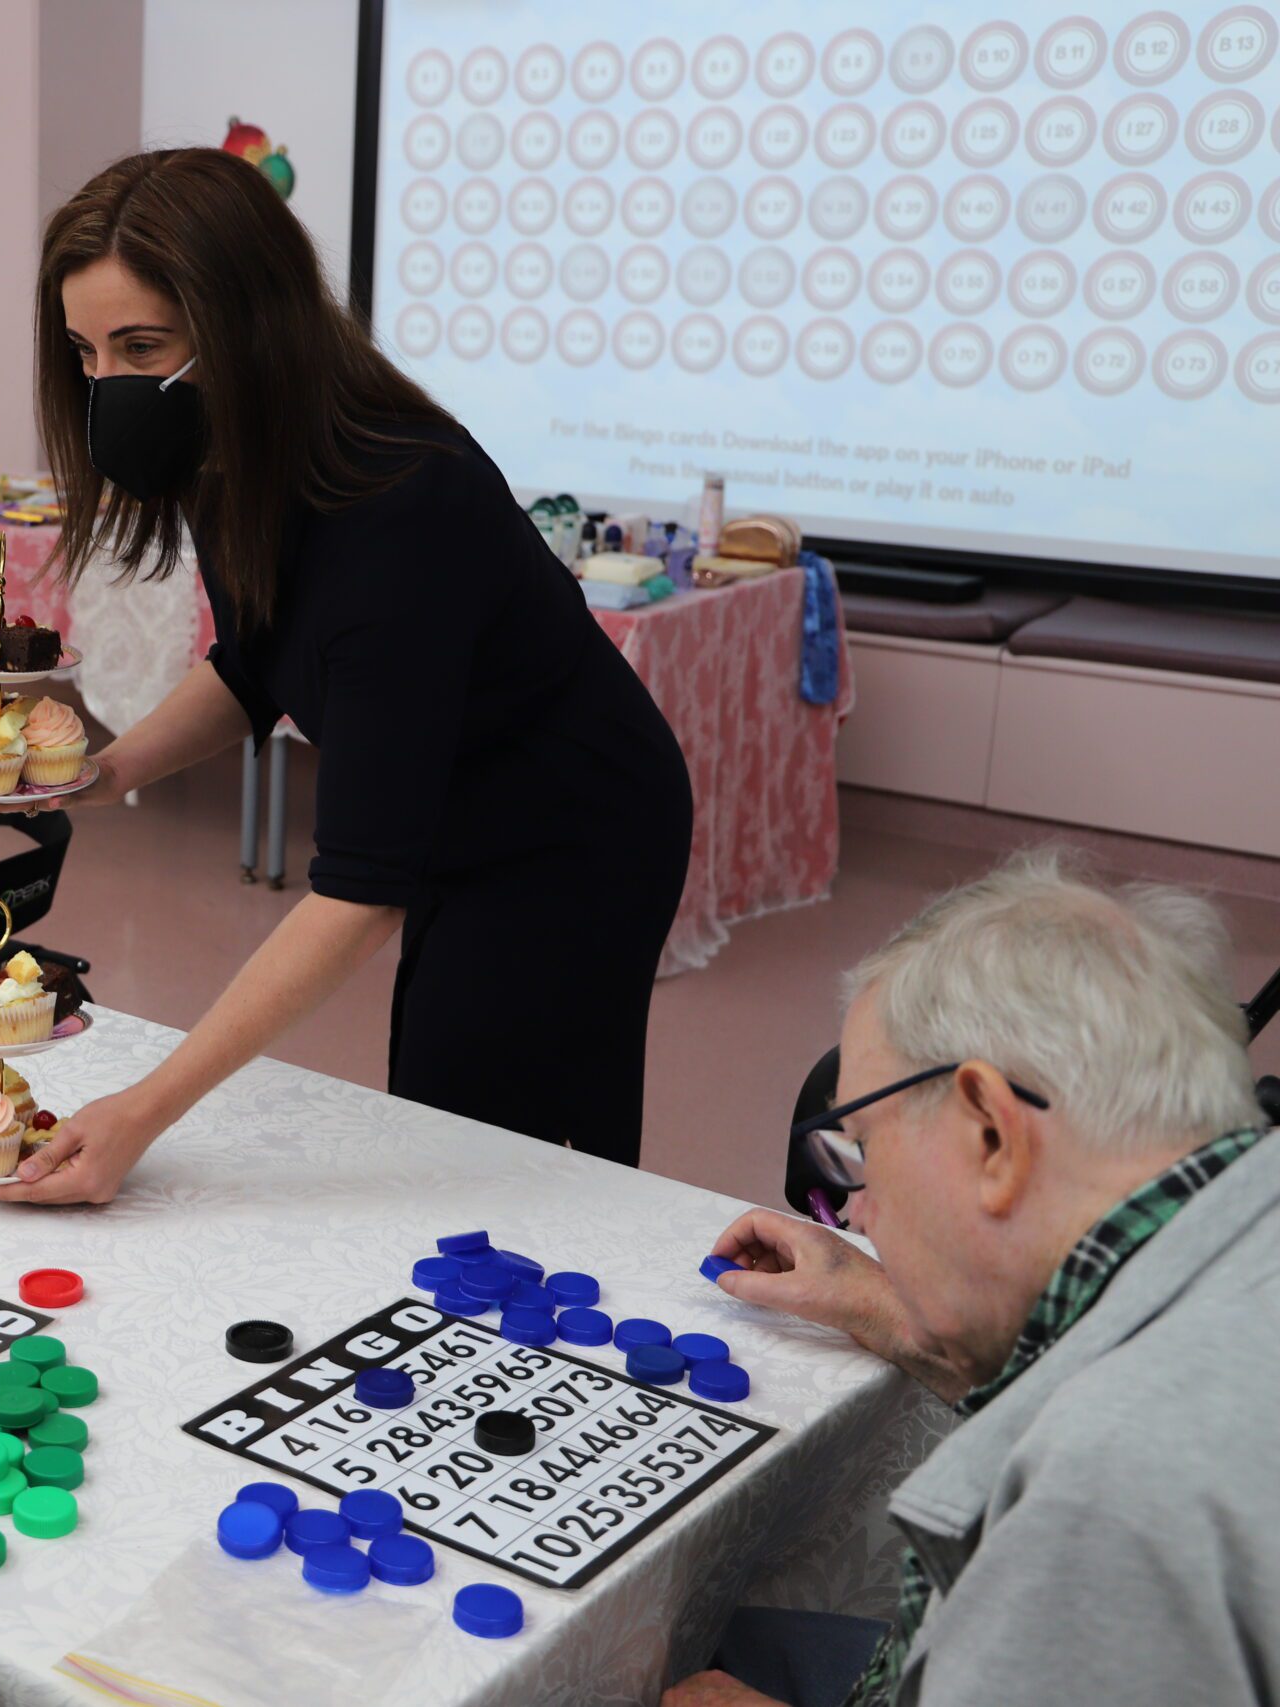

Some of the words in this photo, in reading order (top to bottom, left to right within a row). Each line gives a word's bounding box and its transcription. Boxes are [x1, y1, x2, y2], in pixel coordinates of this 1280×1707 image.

[1151, 40, 1168, 56] 12
[1237, 35, 1255, 51] 13
[992, 48, 1010, 62] 10
[1071, 45, 1085, 59] 11
[1054, 124, 1074, 138] 26
[1135, 121, 1155, 136] 27
[1217, 118, 1240, 134] 28
[1127, 201, 1148, 215] 42
[1210, 200, 1231, 215] 43
[1118, 278, 1137, 292] 57
[1198, 279, 1219, 294] 58
[1189, 356, 1207, 372] 73
[583, 417, 609, 437] the
[615, 421, 663, 446] Bingo
[669, 430, 717, 447] cards
[723, 431, 812, 454] Download
[818, 437, 848, 456] the
[854, 444, 890, 463] app
[895, 449, 918, 461] on
[925, 450, 968, 467] your
[975, 448, 1046, 474] iPhone
[1052, 457, 1075, 474] or
[1081, 455, 1132, 479] iPad
[629, 455, 675, 477] Press
[783, 469, 844, 492] button
[849, 478, 868, 493] or
[875, 477, 913, 502] play
[920, 480, 932, 499] it
[938, 485, 963, 501] on
[970, 486, 1014, 506] auto
[198, 1305, 444, 1446] BINGO
[280, 1434, 320, 1456] 4
[308, 1404, 372, 1434] 16
[396, 1351, 458, 1384] 54
[438, 1330, 494, 1358] 61
[332, 1458, 377, 1484] 5
[367, 1426, 432, 1463] 28
[417, 1400, 475, 1433] 43
[452, 1373, 511, 1408] 59
[496, 1348, 552, 1380] 65
[398, 1486, 440, 1510] 6
[428, 1450, 494, 1490] 20
[513, 1396, 574, 1432] 50
[549, 1370, 613, 1404] 73
[454, 1512, 499, 1539] 7
[488, 1478, 556, 1512] 18
[540, 1446, 602, 1483] 44
[579, 1420, 638, 1454] 46
[616, 1392, 677, 1426] 64
[512, 1533, 582, 1572] 10
[557, 1499, 624, 1542] 25
[599, 1468, 665, 1508] 35
[638, 1442, 704, 1480] 53
[674, 1414, 742, 1451] 74
